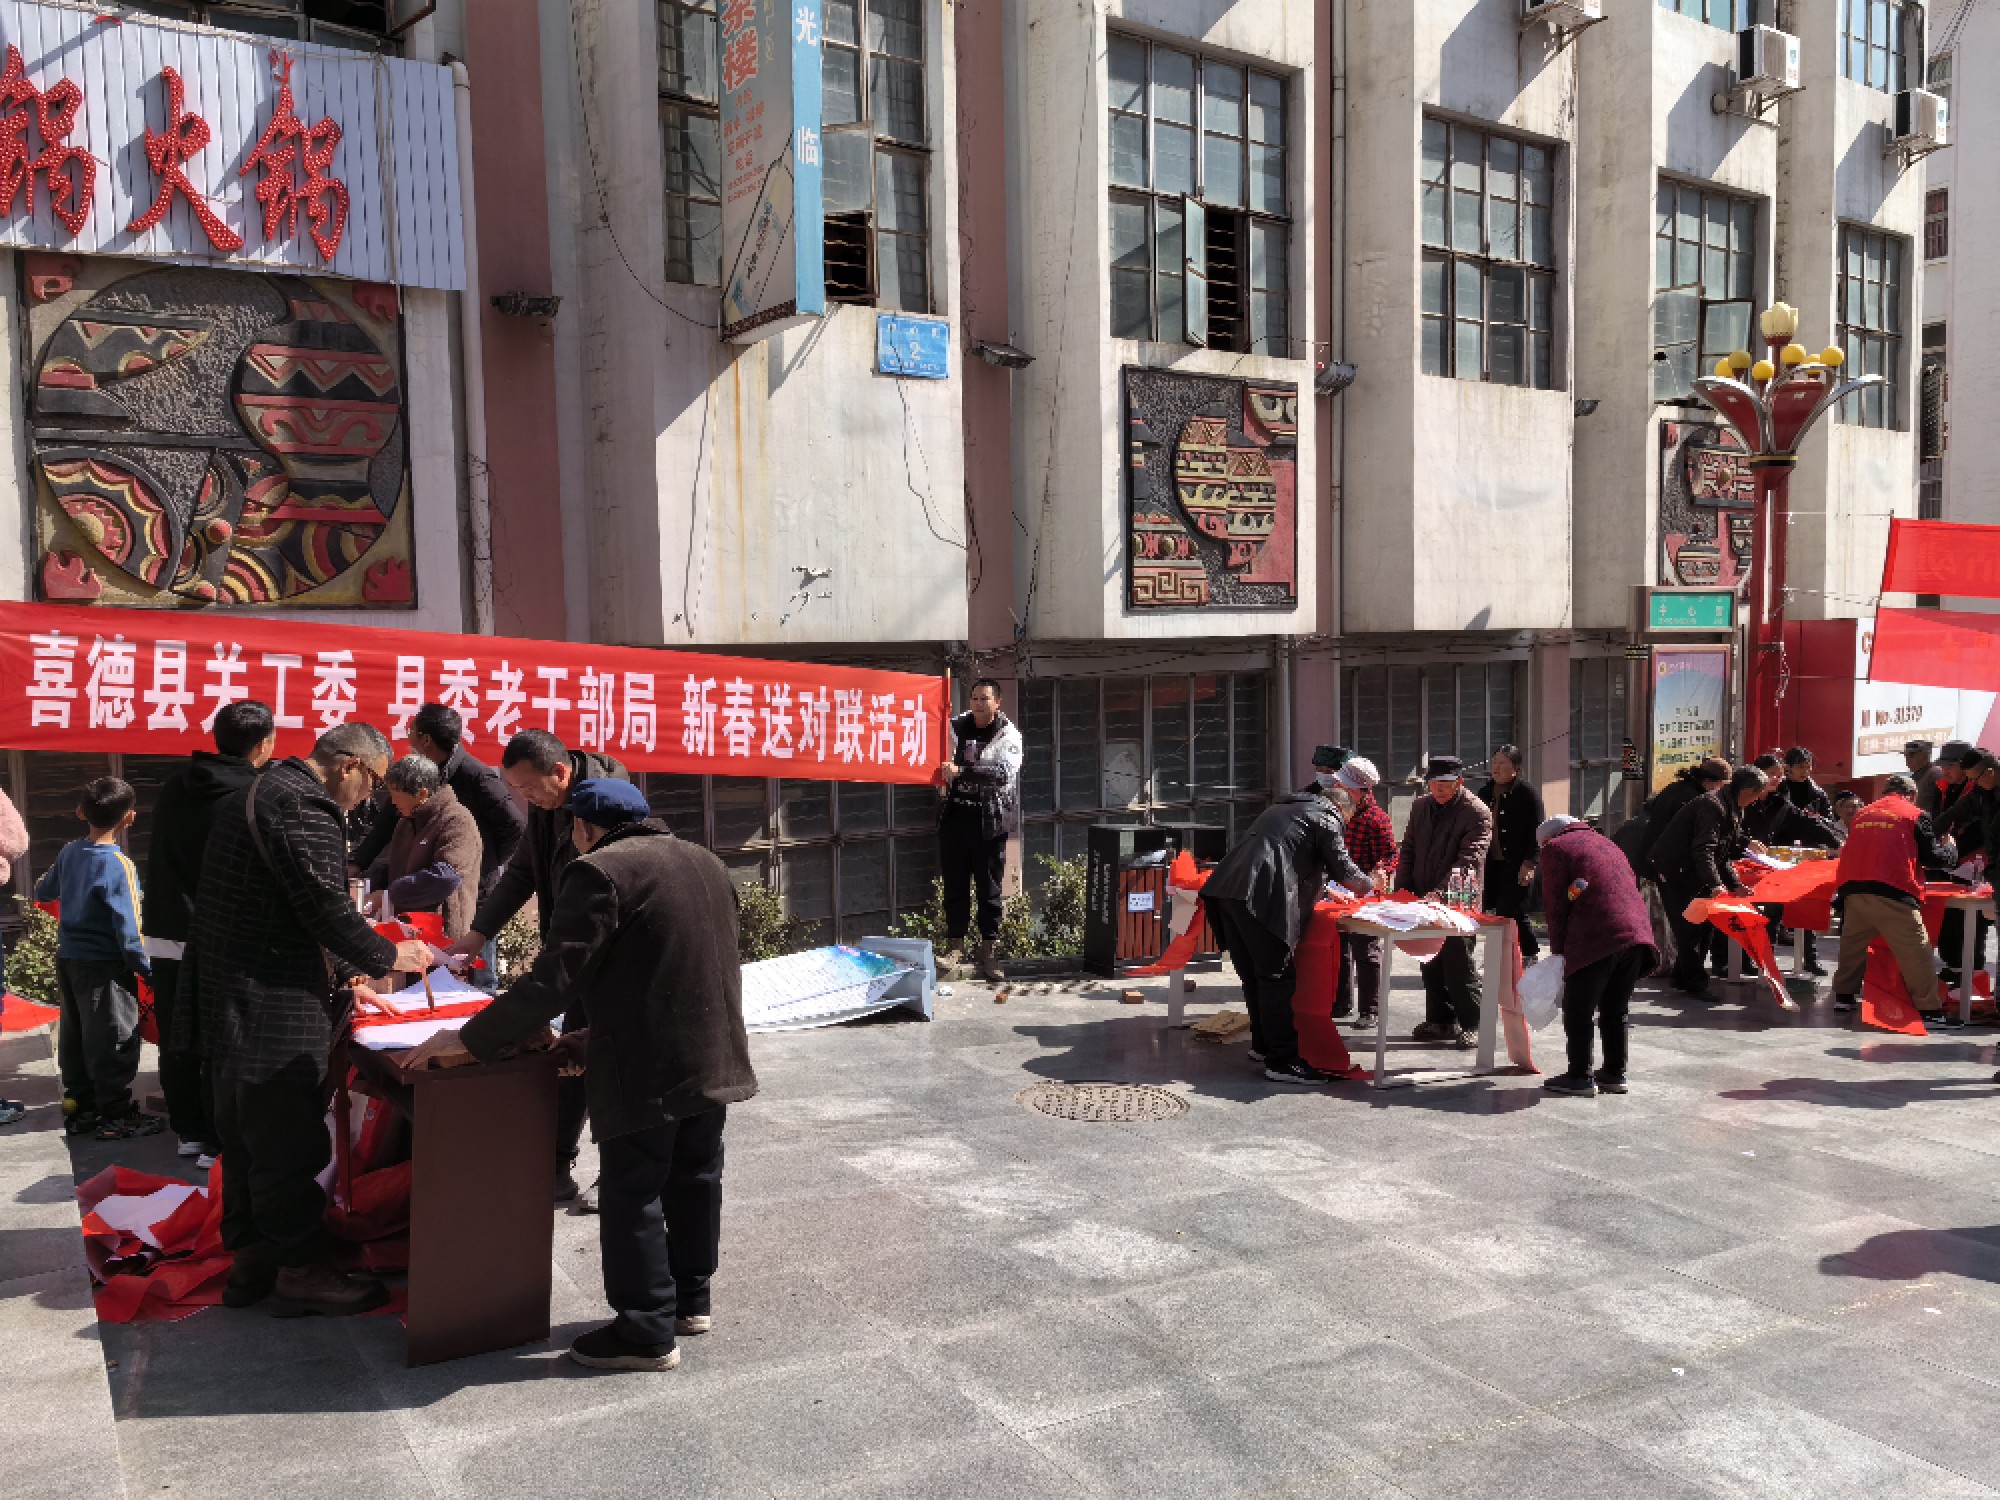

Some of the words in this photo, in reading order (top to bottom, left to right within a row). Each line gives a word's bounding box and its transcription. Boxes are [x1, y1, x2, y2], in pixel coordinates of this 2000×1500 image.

[25, 629, 357, 741] 喜德县关工委
[388, 656, 657, 754] 县委老干部局
[681, 673, 928, 767] 新春送对联活动
